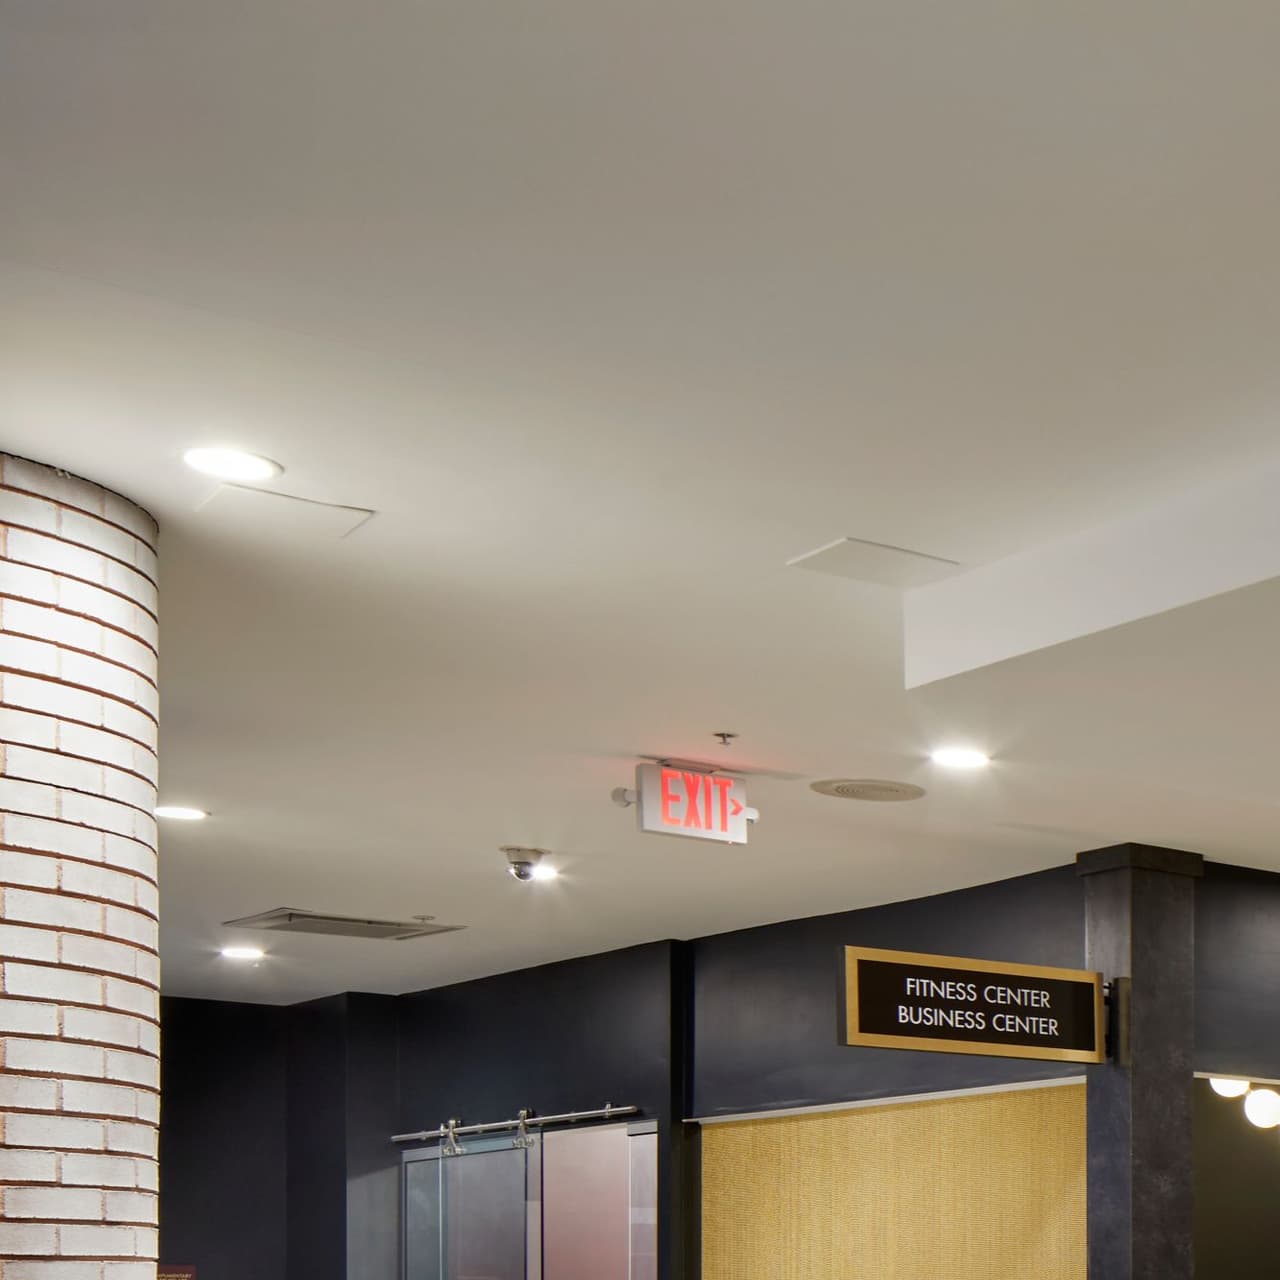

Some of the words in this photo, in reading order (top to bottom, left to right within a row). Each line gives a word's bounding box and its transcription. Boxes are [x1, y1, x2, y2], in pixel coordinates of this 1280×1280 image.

[661, 768, 734, 832] EXIT
[905, 977, 977, 1002] FITNESS
[984, 985, 1051, 1008] CENTER
[898, 1005, 986, 1030] BUSINESS
[992, 1013, 1060, 1036] CENTER
